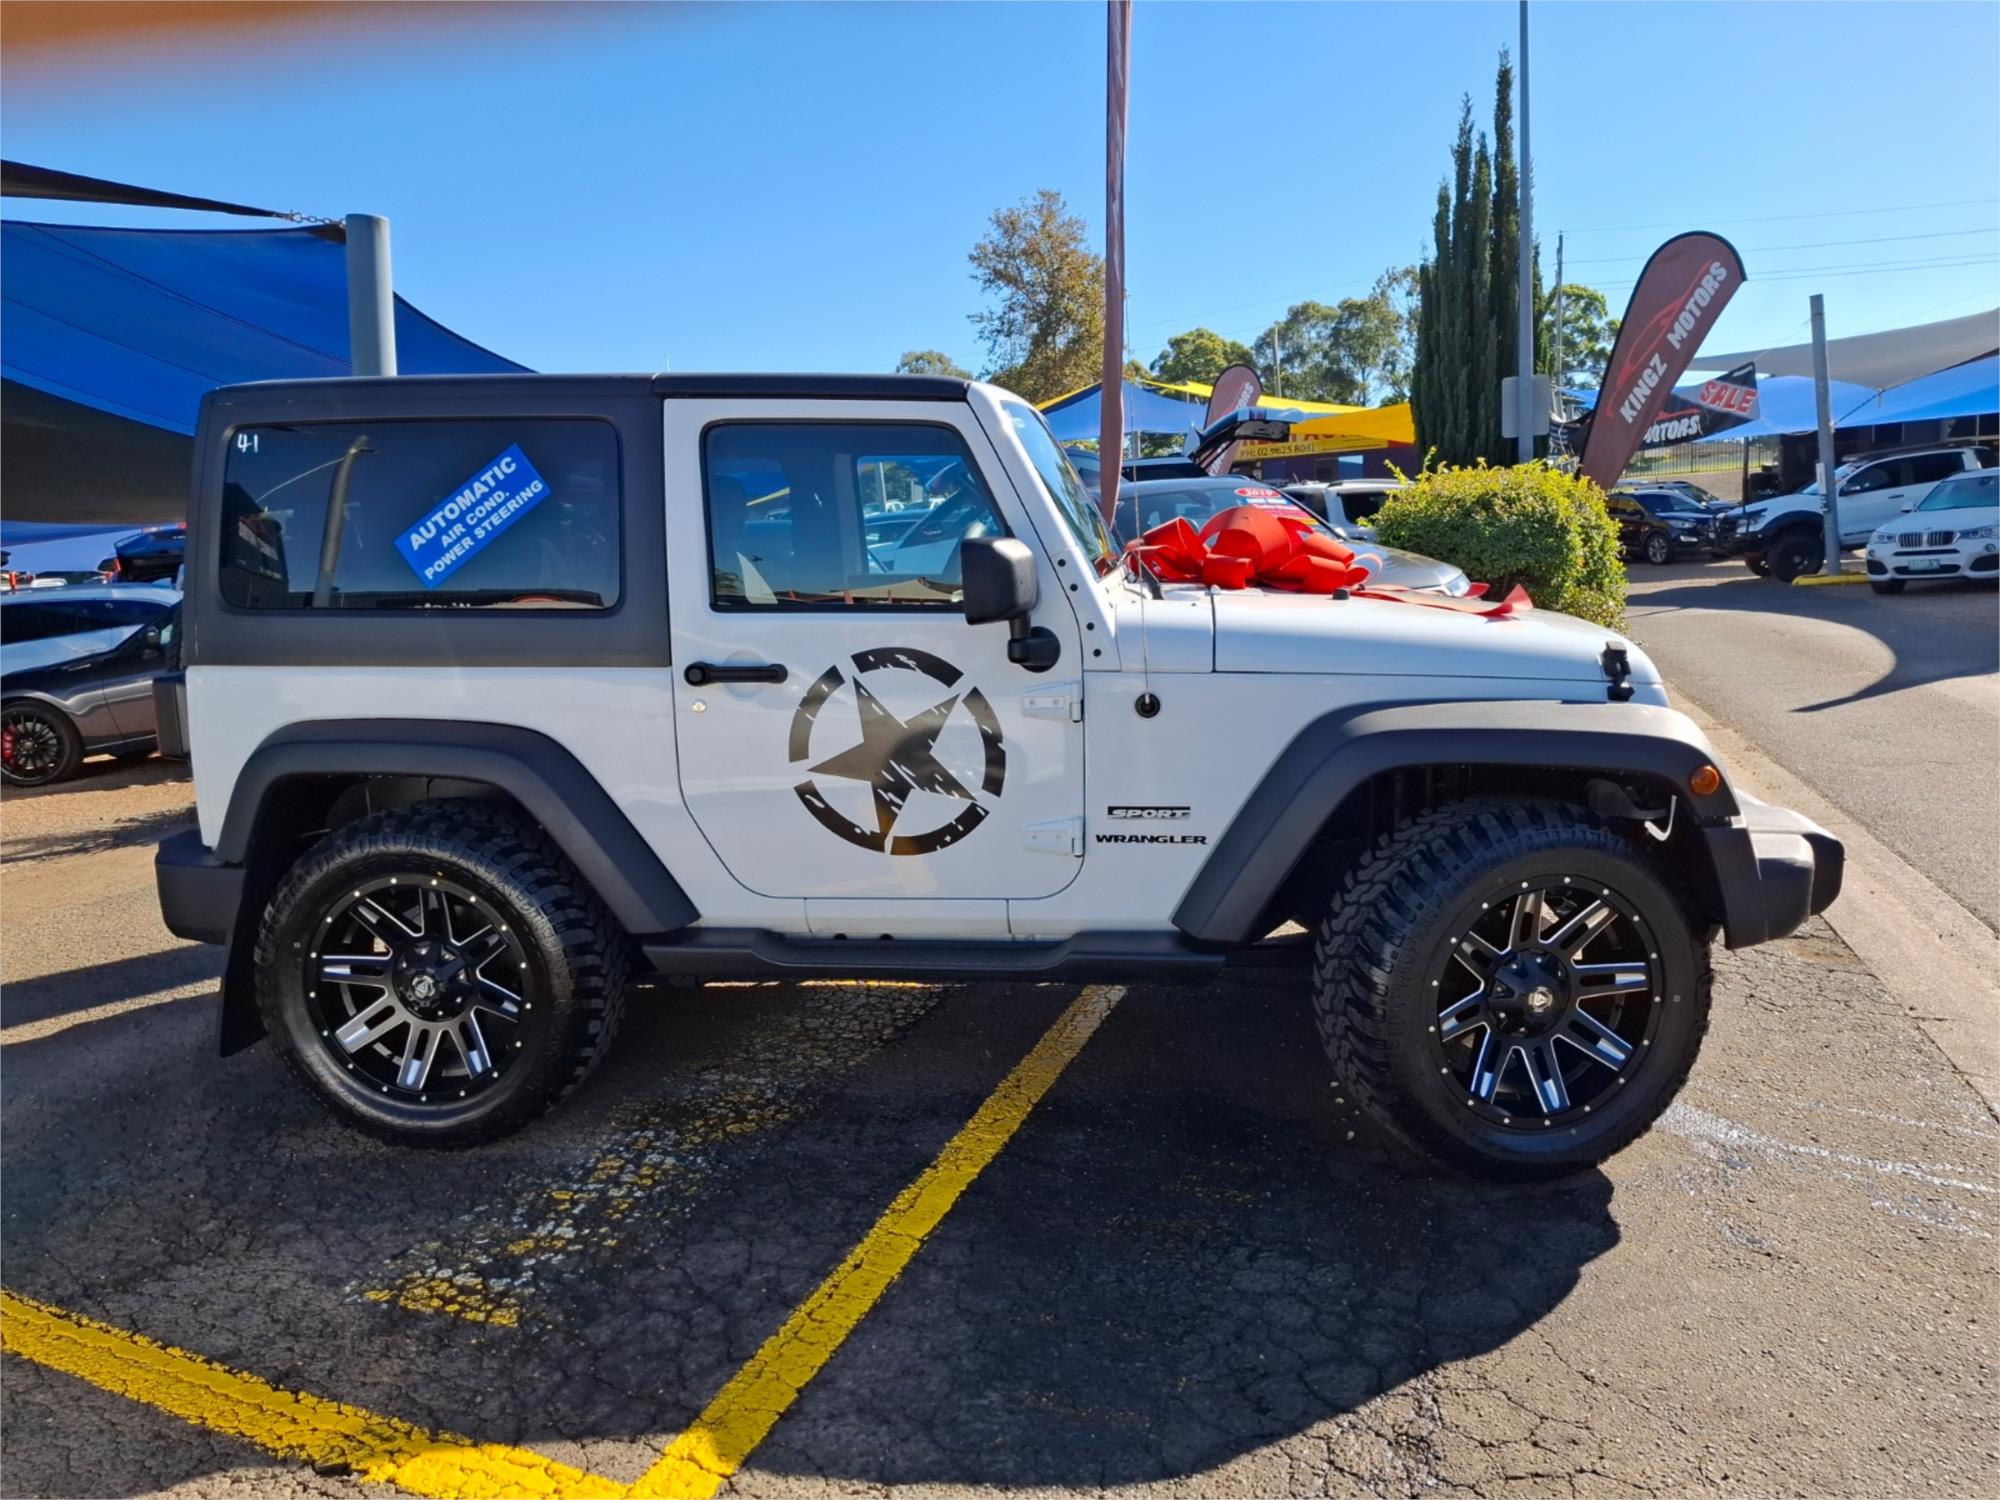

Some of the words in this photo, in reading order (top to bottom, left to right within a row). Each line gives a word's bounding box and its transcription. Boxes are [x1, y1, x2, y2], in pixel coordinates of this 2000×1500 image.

[1619, 353, 1668, 424] KINGZ
[1667, 261, 1728, 350] MOTORS
[1700, 379, 1757, 414] SALE
[237, 433, 259, 453] 41
[1257, 447, 1268, 456] 02
[1270, 445, 1293, 455] 9625
[410, 456, 516, 551] AUTOMATIC
[441, 523, 466, 548] AIR
[465, 490, 510, 525] COND.
[424, 536, 475, 580] POWER
[474, 480, 544, 539] STEERING
[1111, 808, 1190, 819] SPORT
[1096, 834, 1208, 845] WRANGLER
